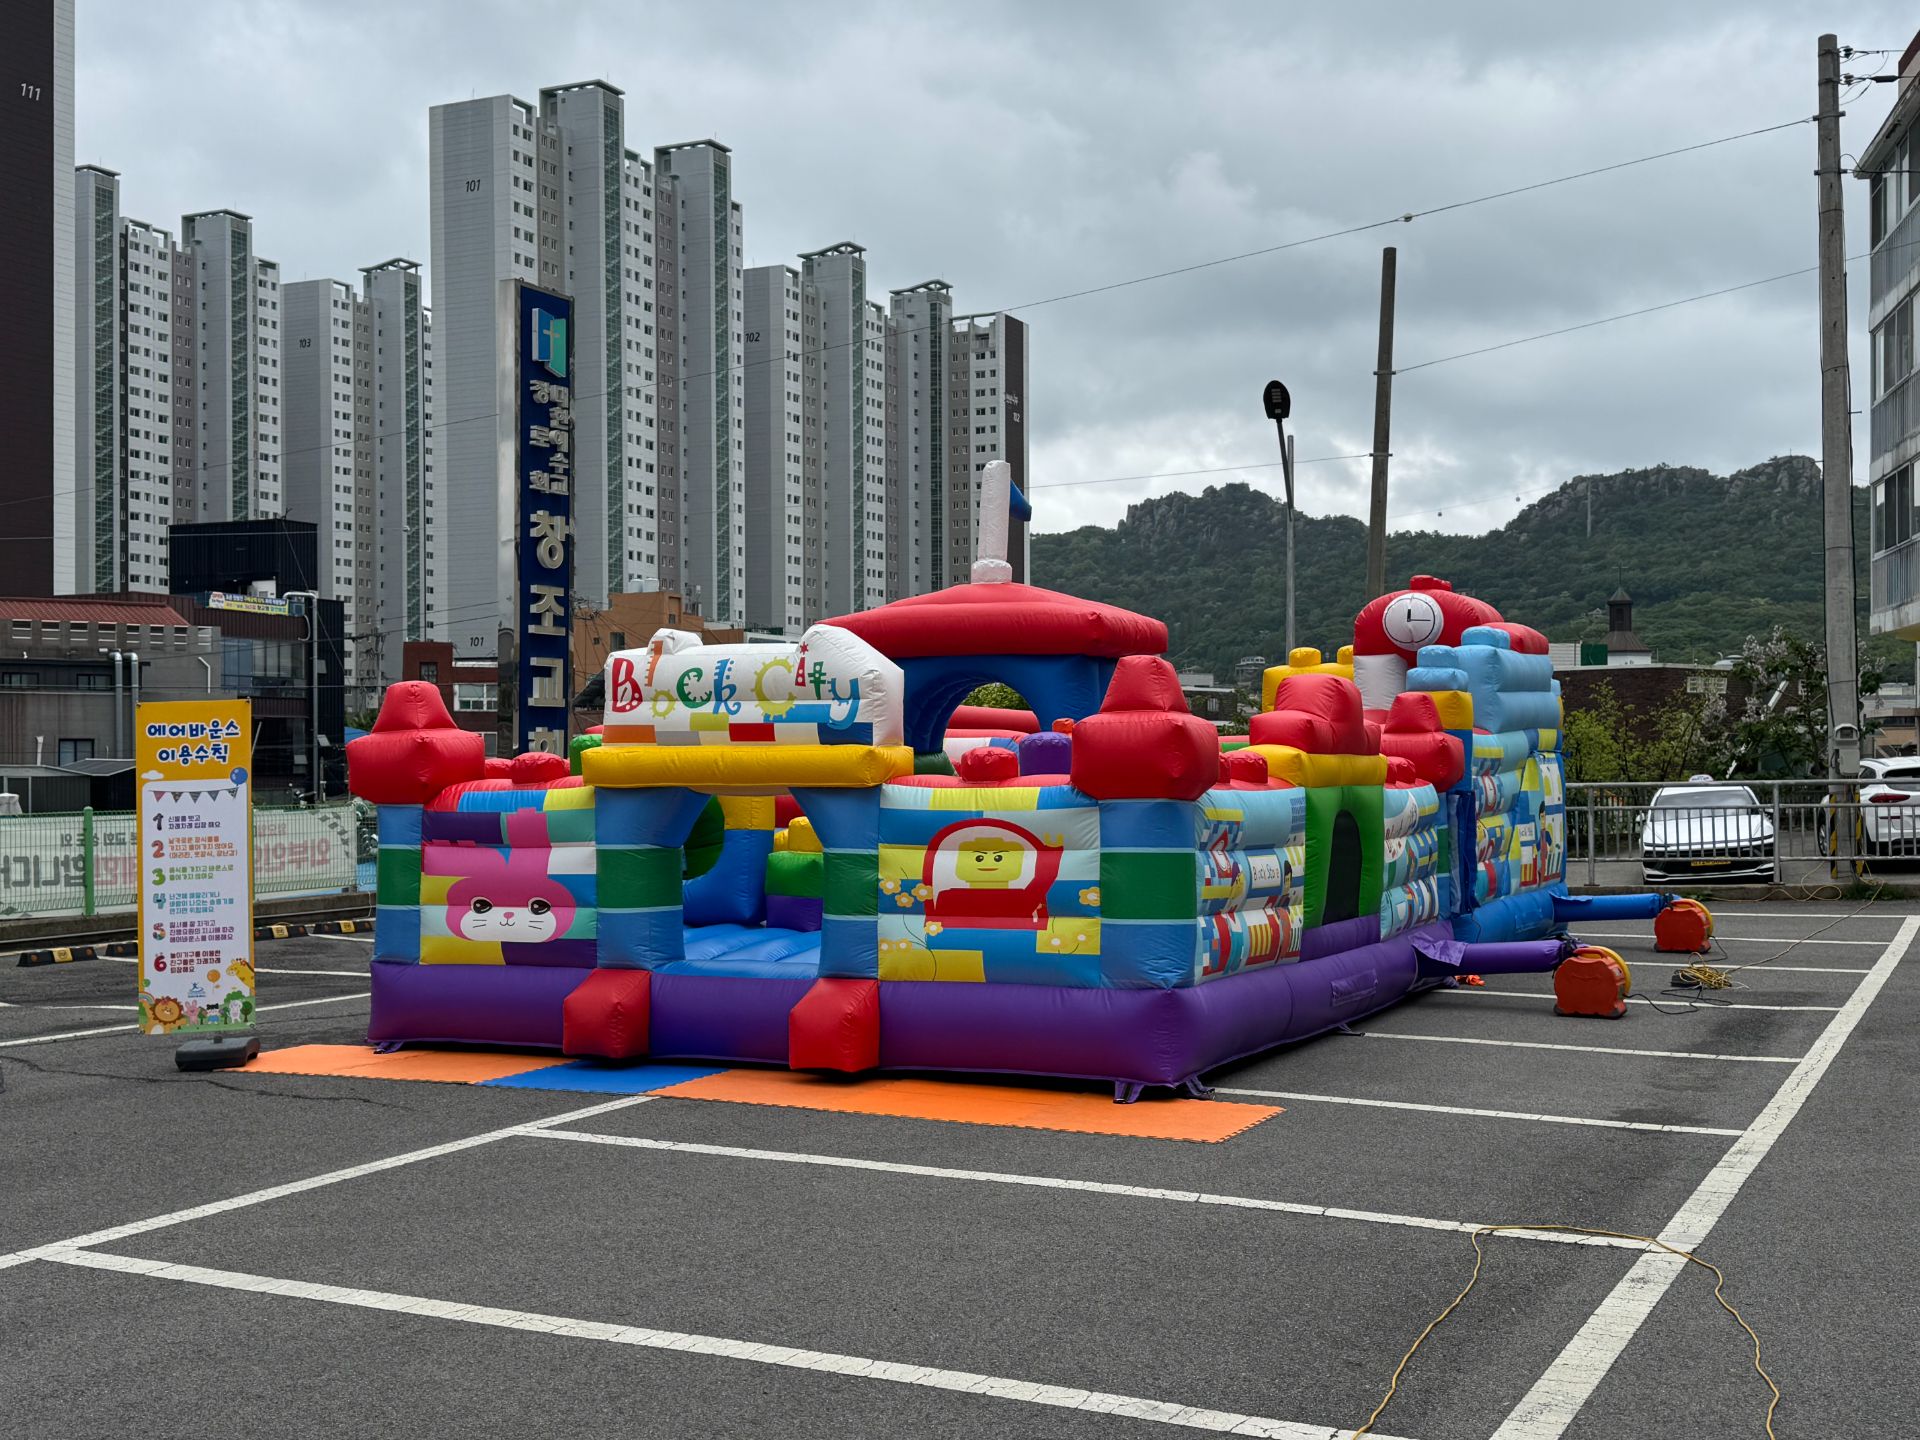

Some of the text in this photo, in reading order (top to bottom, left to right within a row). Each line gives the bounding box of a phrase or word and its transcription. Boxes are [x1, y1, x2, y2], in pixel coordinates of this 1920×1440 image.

[20, 82, 41, 102] 111
[465, 178, 481, 194] 101
[298, 338, 312, 349] 103
[745, 332, 760, 343] 102
[470, 636, 484, 647] 101
[611, 640, 860, 730] Block City
[146, 719, 241, 742] 에어바운스
[157, 743, 230, 766] 이용수칙
[153, 813, 164, 831] 1
[152, 840, 165, 858] 2
[152, 868, 166, 886] 3
[153, 893, 166, 909] 4
[152, 922, 166, 941] 5
[154, 955, 167, 972] 6
